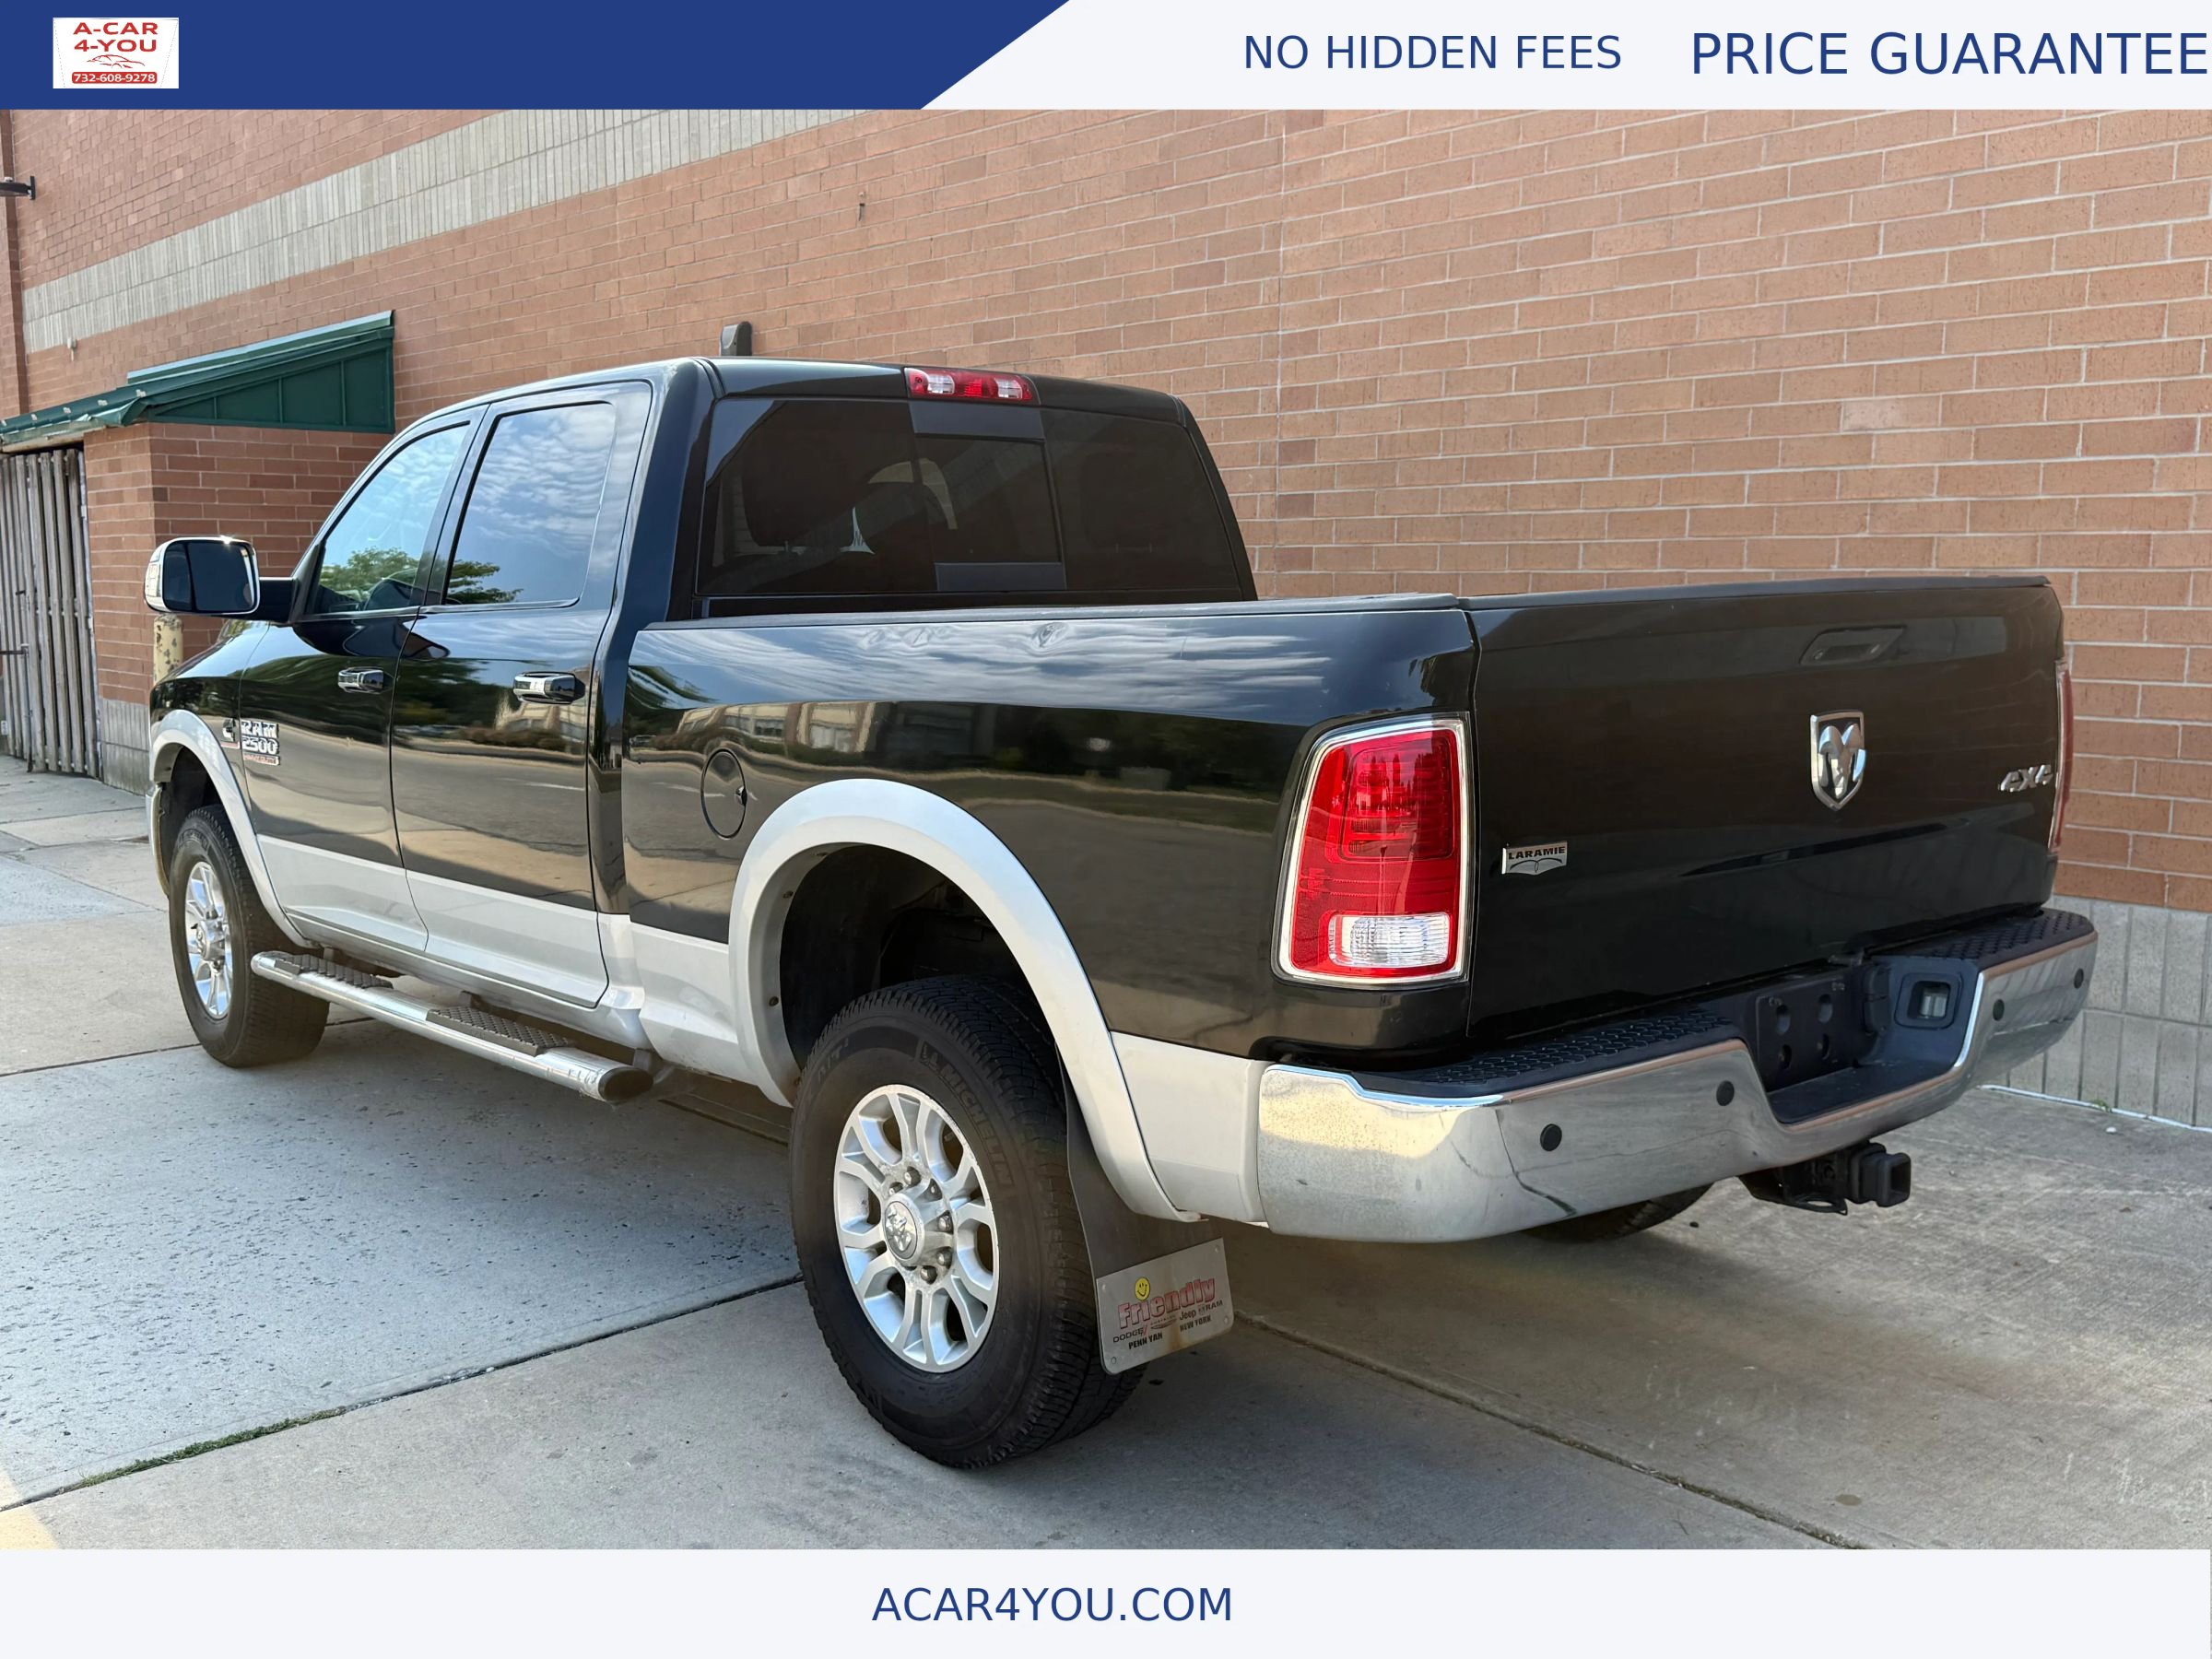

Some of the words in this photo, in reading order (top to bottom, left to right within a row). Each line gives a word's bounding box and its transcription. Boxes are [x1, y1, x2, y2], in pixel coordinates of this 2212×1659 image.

[241, 719, 279, 739] RAM
[241, 735, 279, 755] 2500
[1507, 846, 1566, 860] LARAMIE
[1179, 1309, 1196, 1321] Jeep
[1205, 1300, 1224, 1312] RAM
[1128, 1337, 1148, 1350] PENN
[1149, 1332, 1163, 1344] YAN
[1179, 1321, 1194, 1333] NEW
[1195, 1315, 1212, 1327] YORK
